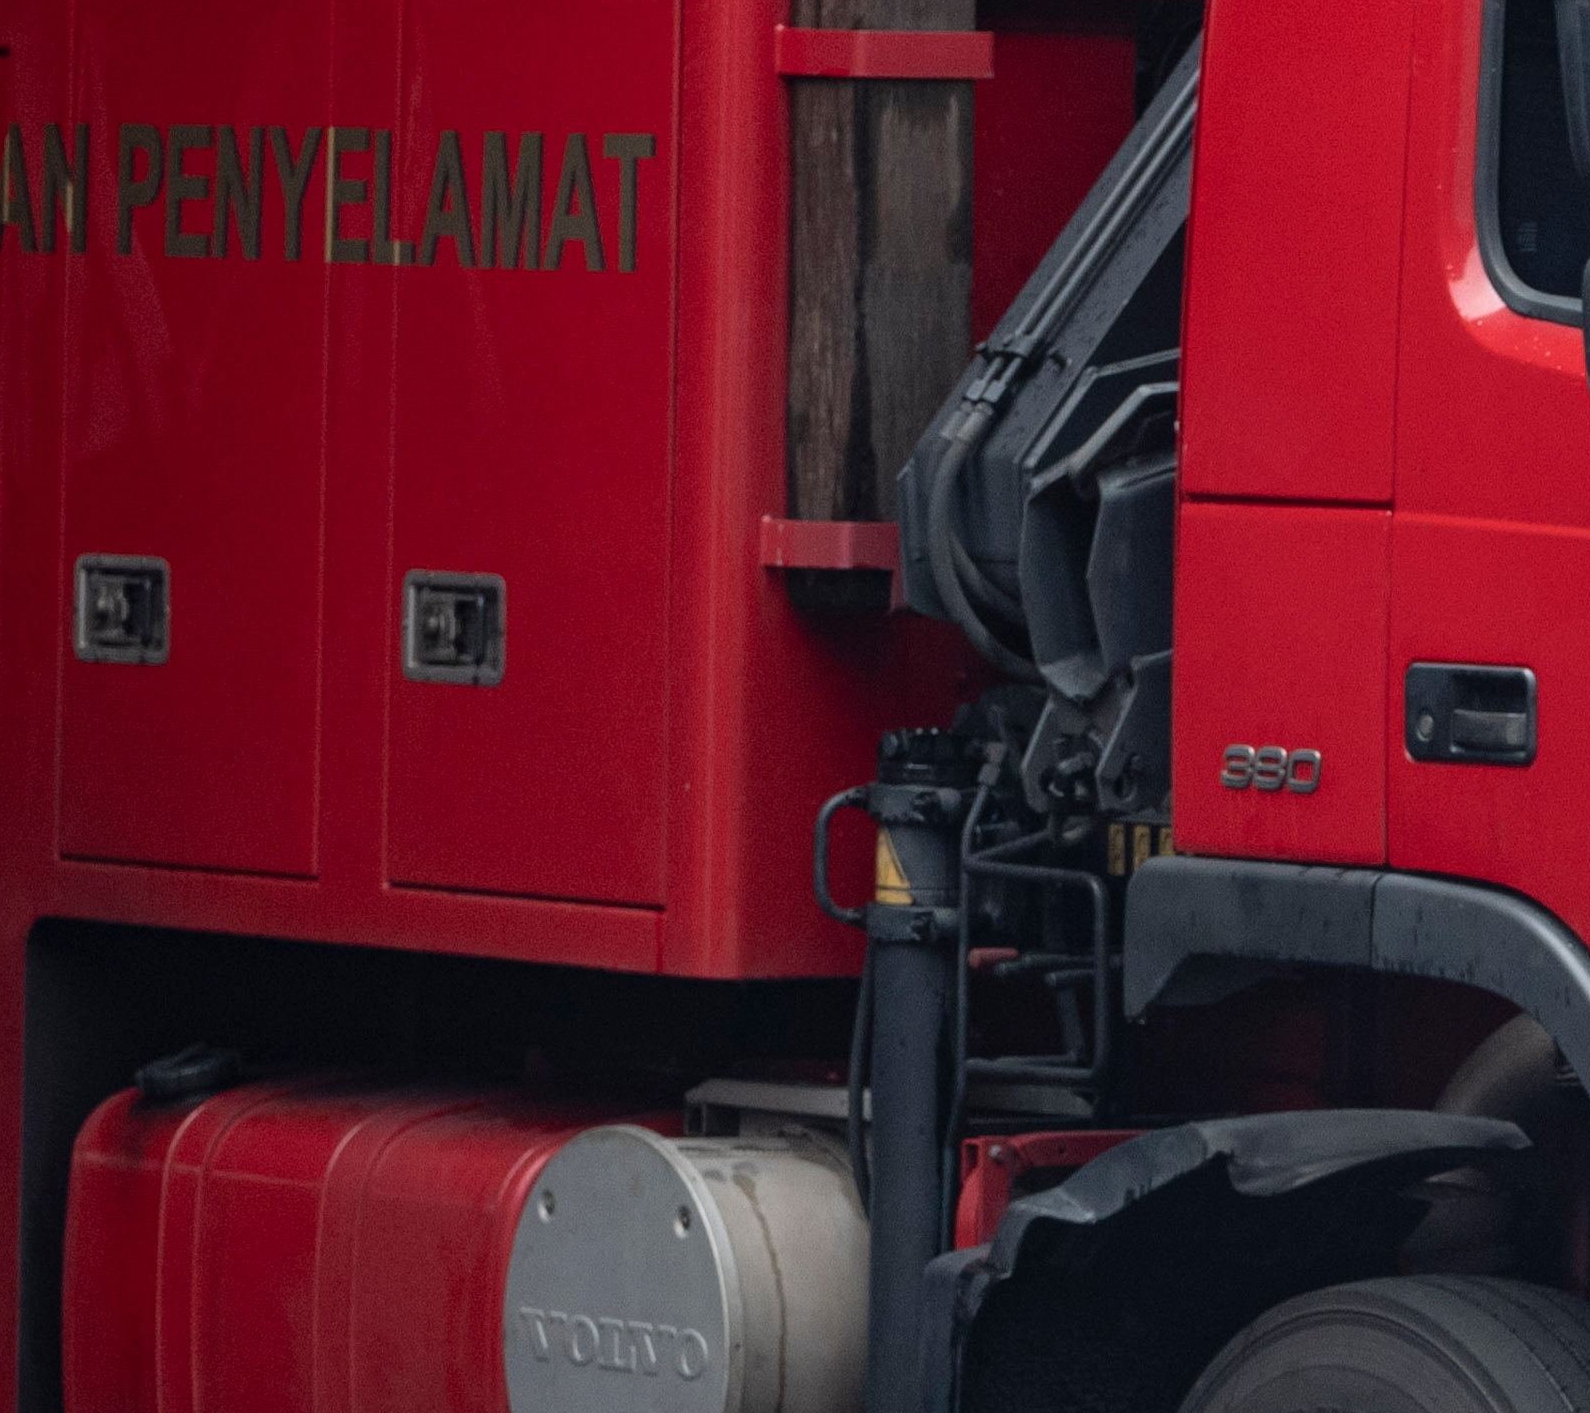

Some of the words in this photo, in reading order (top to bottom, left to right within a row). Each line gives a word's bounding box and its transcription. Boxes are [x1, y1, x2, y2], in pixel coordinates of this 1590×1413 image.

[116, 122, 657, 273] PENYELAMAT
[1221, 744, 1321, 793] 380
[520, 1306, 708, 1381] VOLVO
